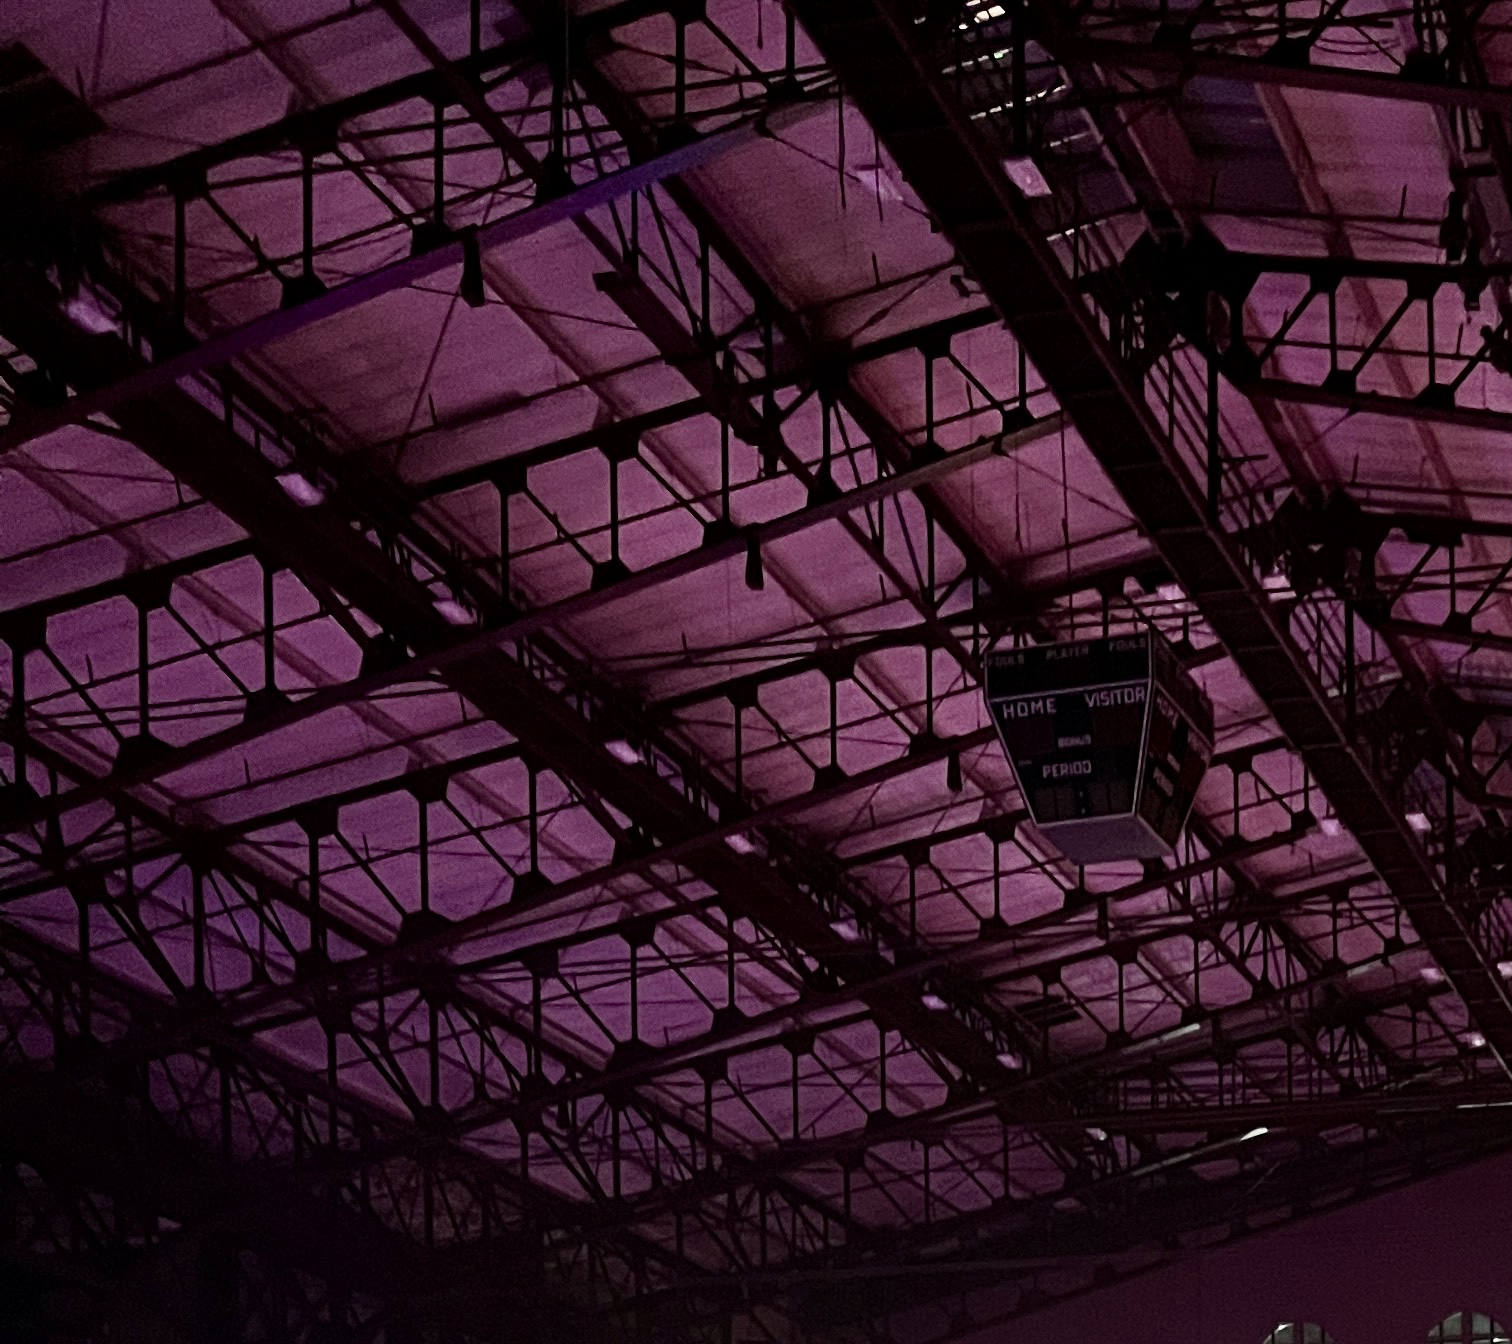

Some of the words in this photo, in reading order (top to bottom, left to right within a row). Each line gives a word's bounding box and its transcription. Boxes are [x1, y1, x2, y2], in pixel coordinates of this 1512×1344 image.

[1045, 643, 1090, 660] PLAYER
[1002, 698, 1057, 719] HOME
[1084, 686, 1146, 708] VISITOR
[1042, 759, 1092, 779] PERIOD
